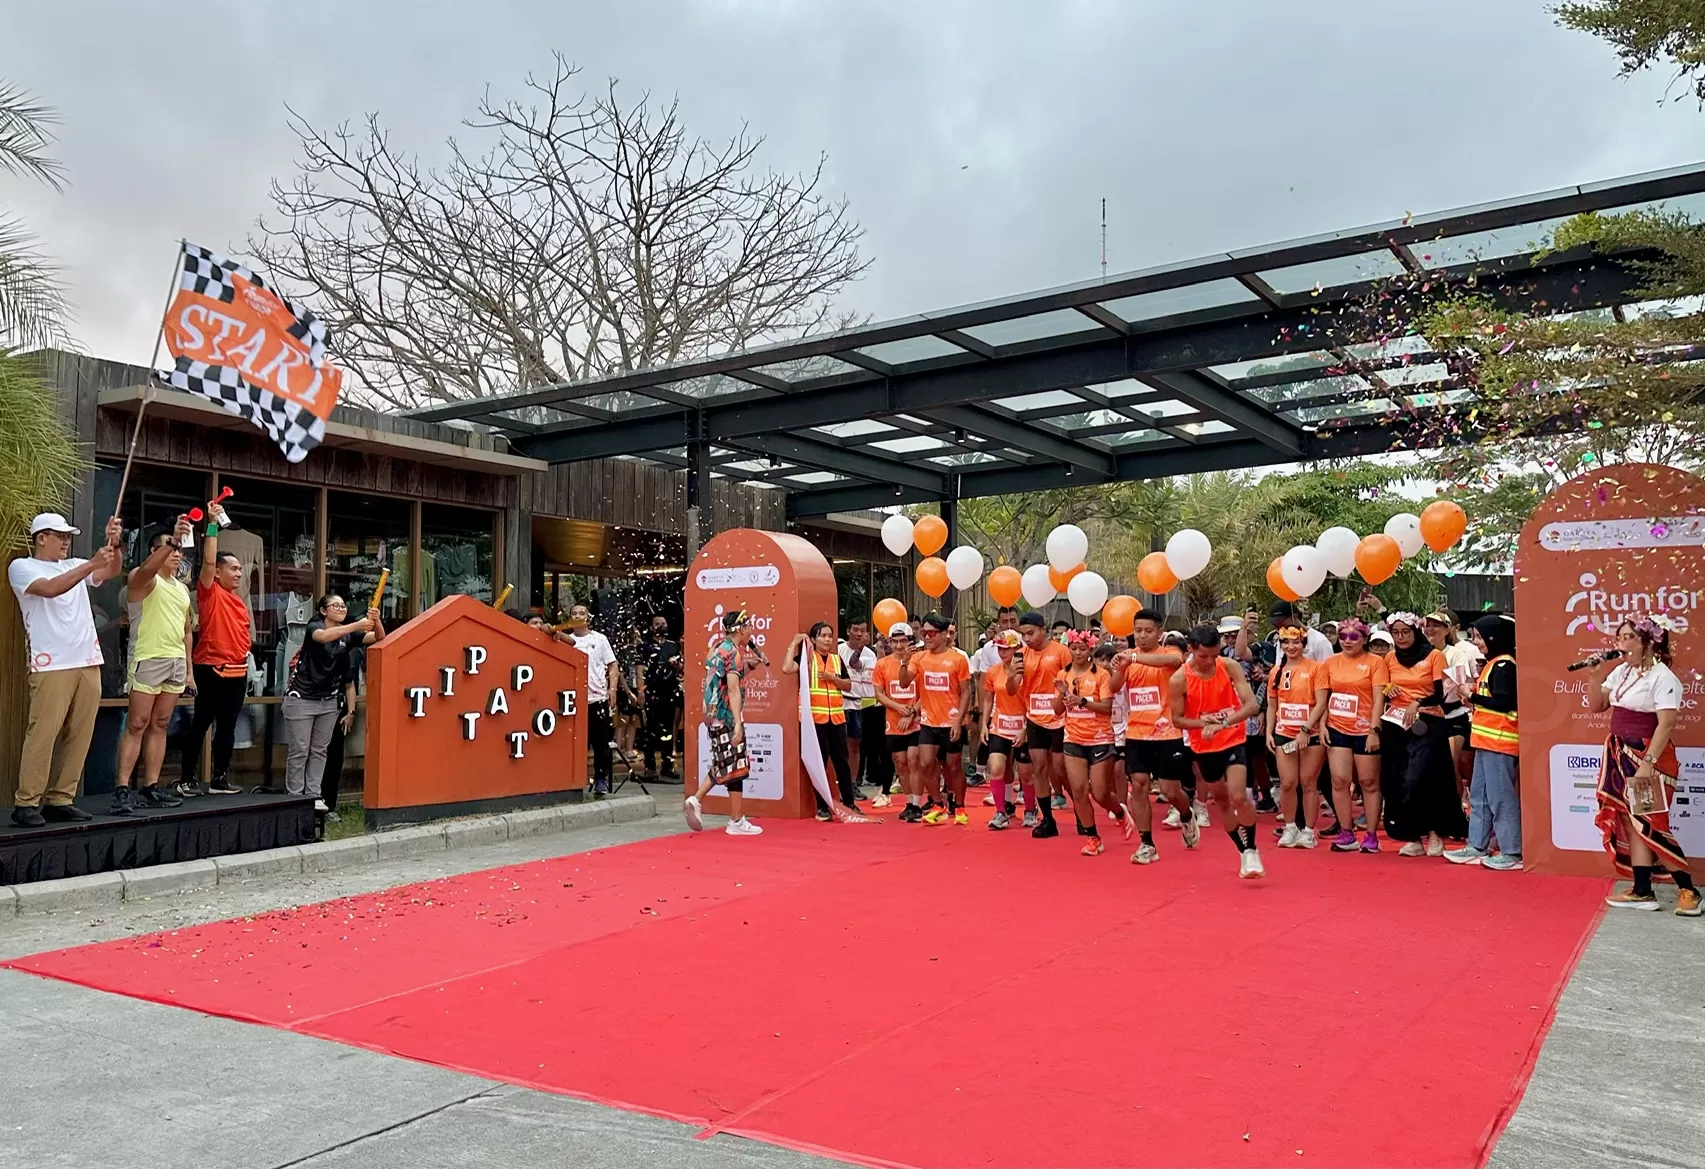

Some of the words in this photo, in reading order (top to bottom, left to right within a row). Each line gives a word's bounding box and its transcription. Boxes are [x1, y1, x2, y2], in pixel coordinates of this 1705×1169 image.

[1589, 590, 1651, 611] Run
[1656, 586, 1698, 610] for
[750, 613, 773, 630] for
[749, 678, 779, 688] Shelter
[746, 688, 768, 701] Hope
[1135, 693, 1153, 704] PACER
[1333, 699, 1351, 710] PACER
[1284, 709, 1303, 719] PACER
[1002, 720, 1019, 729] PACER
